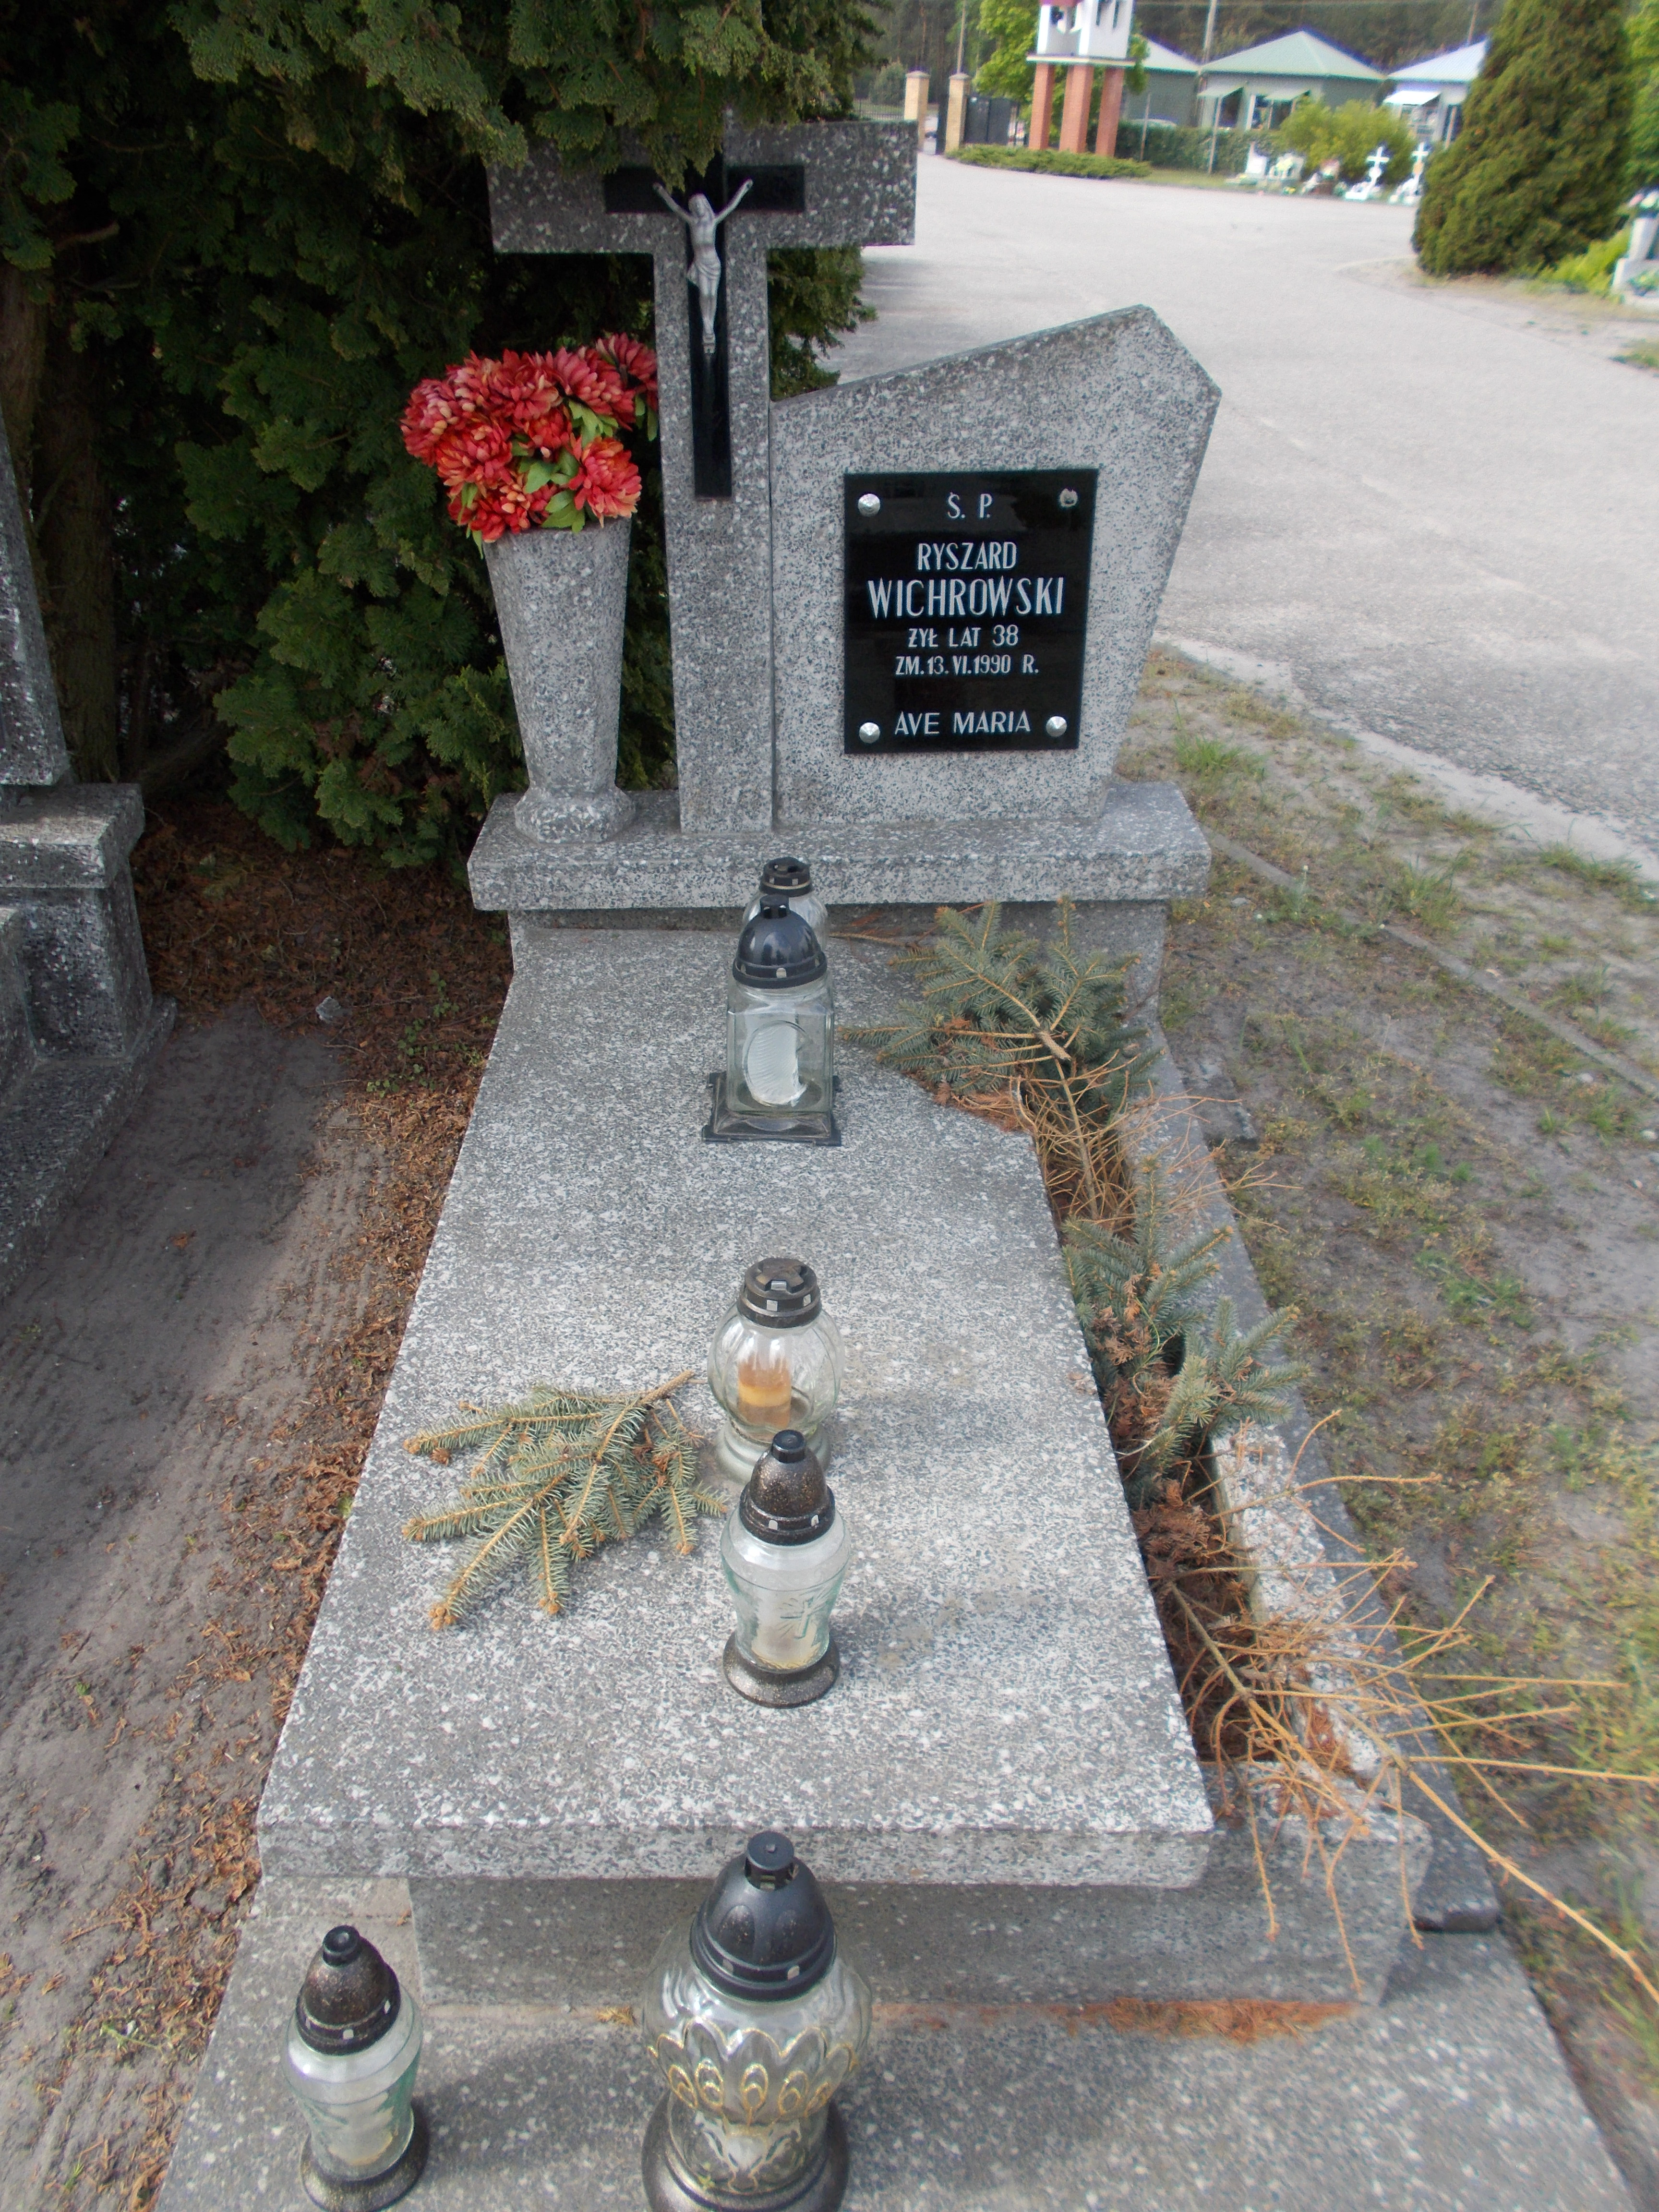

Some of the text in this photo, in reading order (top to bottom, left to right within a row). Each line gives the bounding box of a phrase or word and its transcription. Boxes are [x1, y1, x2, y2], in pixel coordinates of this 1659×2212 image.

[979, 493, 992, 518] P.
[917, 541, 1017, 570] RYSZARD
[867, 576, 1064, 618] WICHROWSKI
[949, 626, 981, 647] LAT
[992, 624, 1019, 646] 38
[1022, 654, 1039, 673] R.
[894, 710, 1031, 735] AVE MARIA
